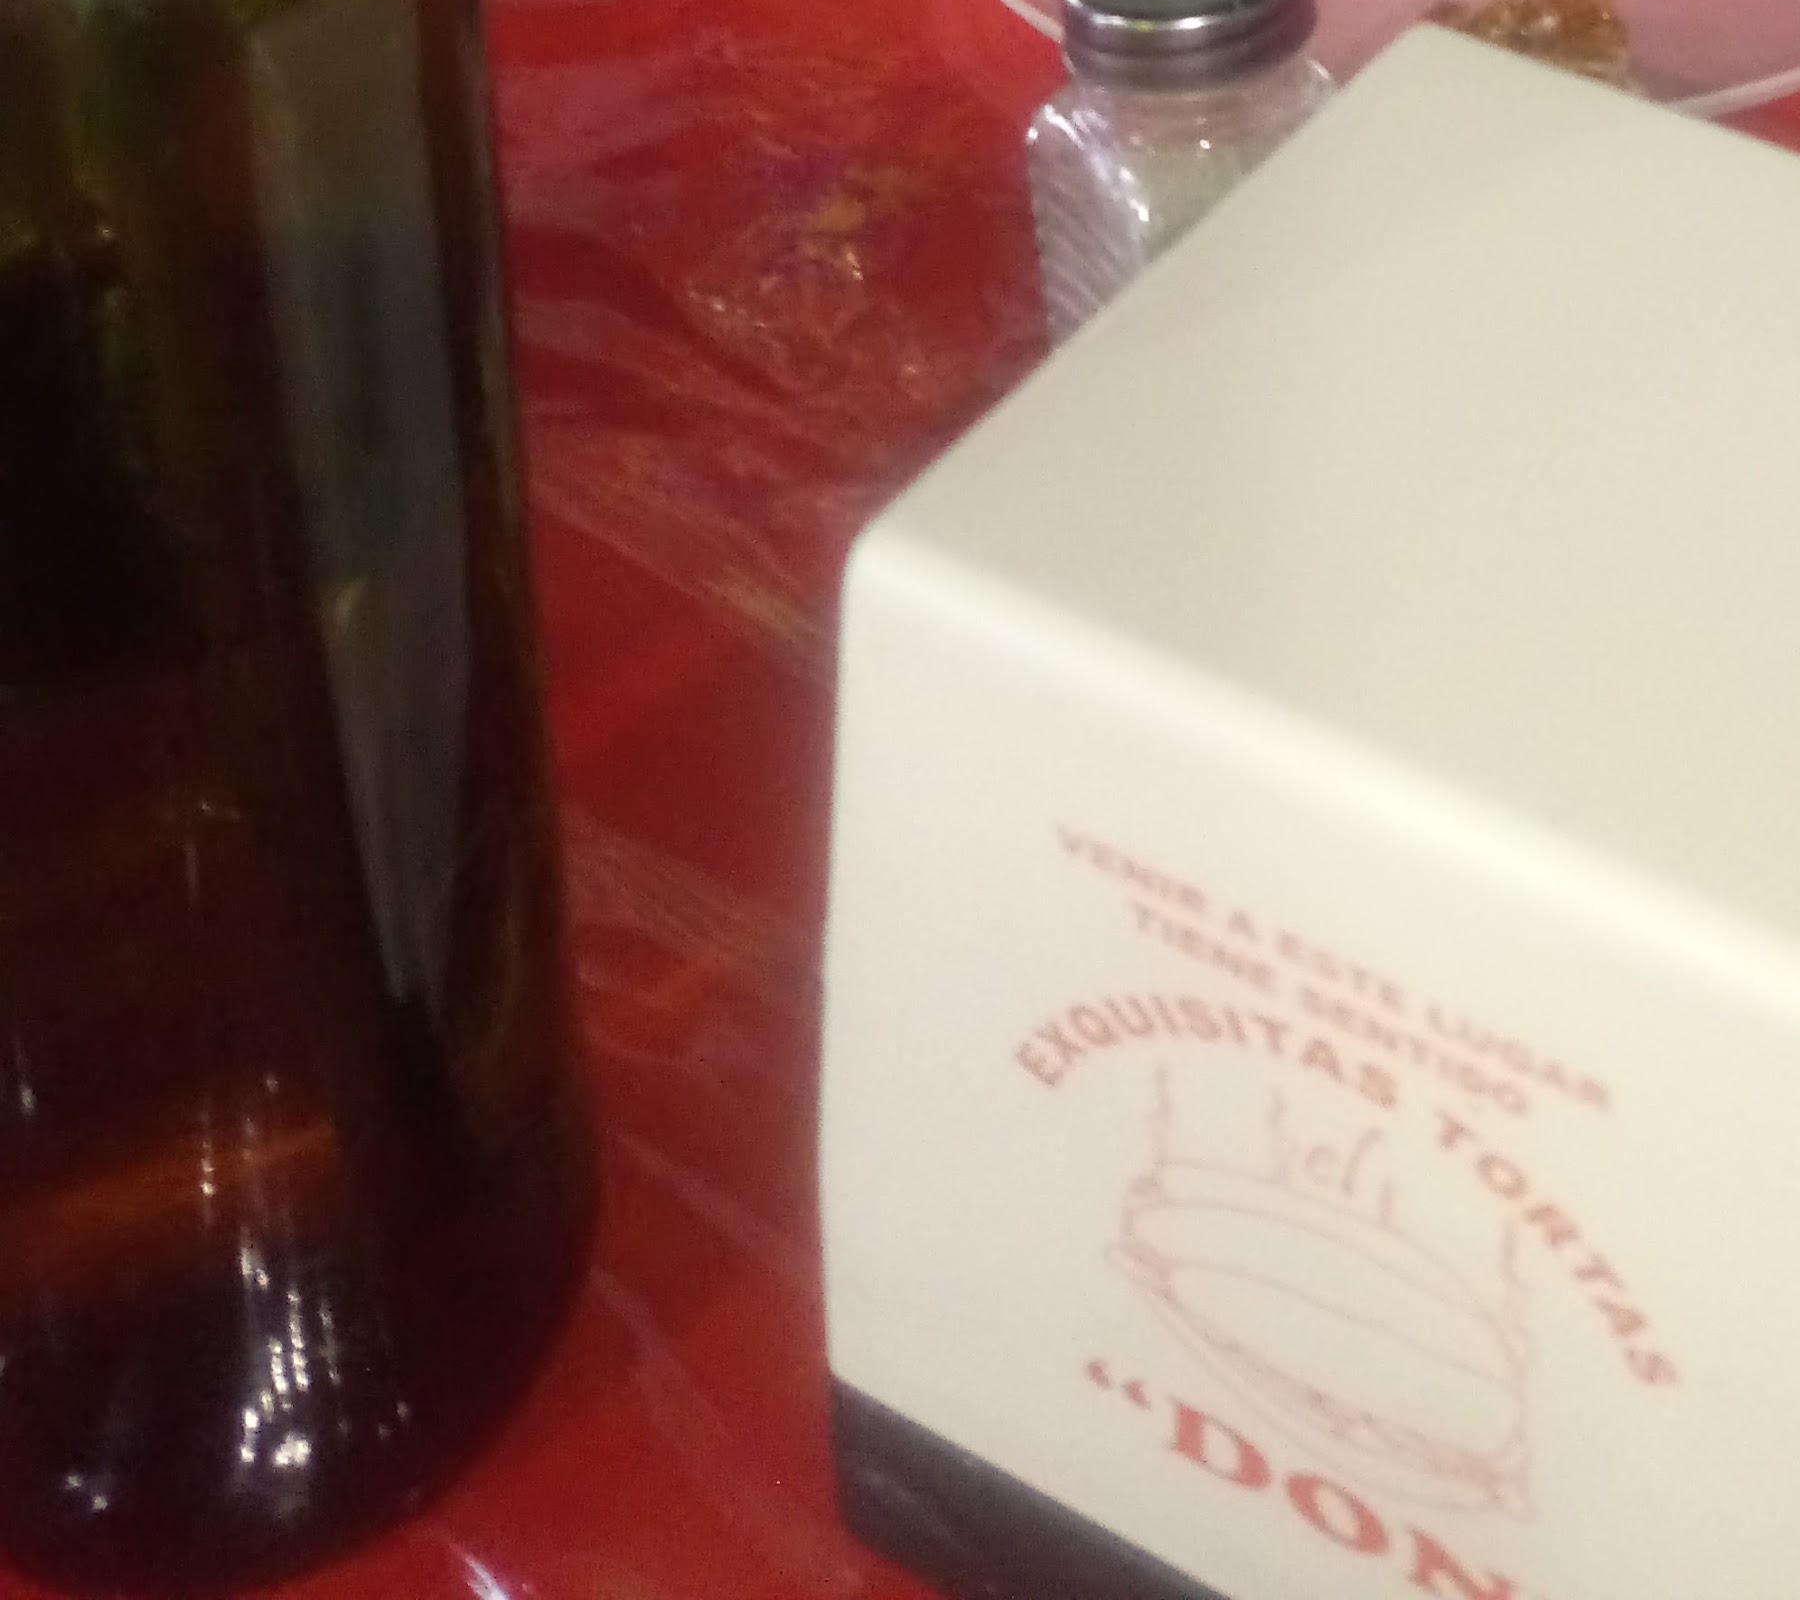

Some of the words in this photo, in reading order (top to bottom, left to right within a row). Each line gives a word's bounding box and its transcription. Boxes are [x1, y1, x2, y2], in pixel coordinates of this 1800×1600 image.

[1015, 994, 1399, 1109] EXQUISITAS
[1227, 908, 1260, 942] A
[1276, 927, 1404, 1014] ESTE
[1425, 1000, 1612, 1113] LUGAR
[1434, 1107, 1681, 1387] TORTAS
